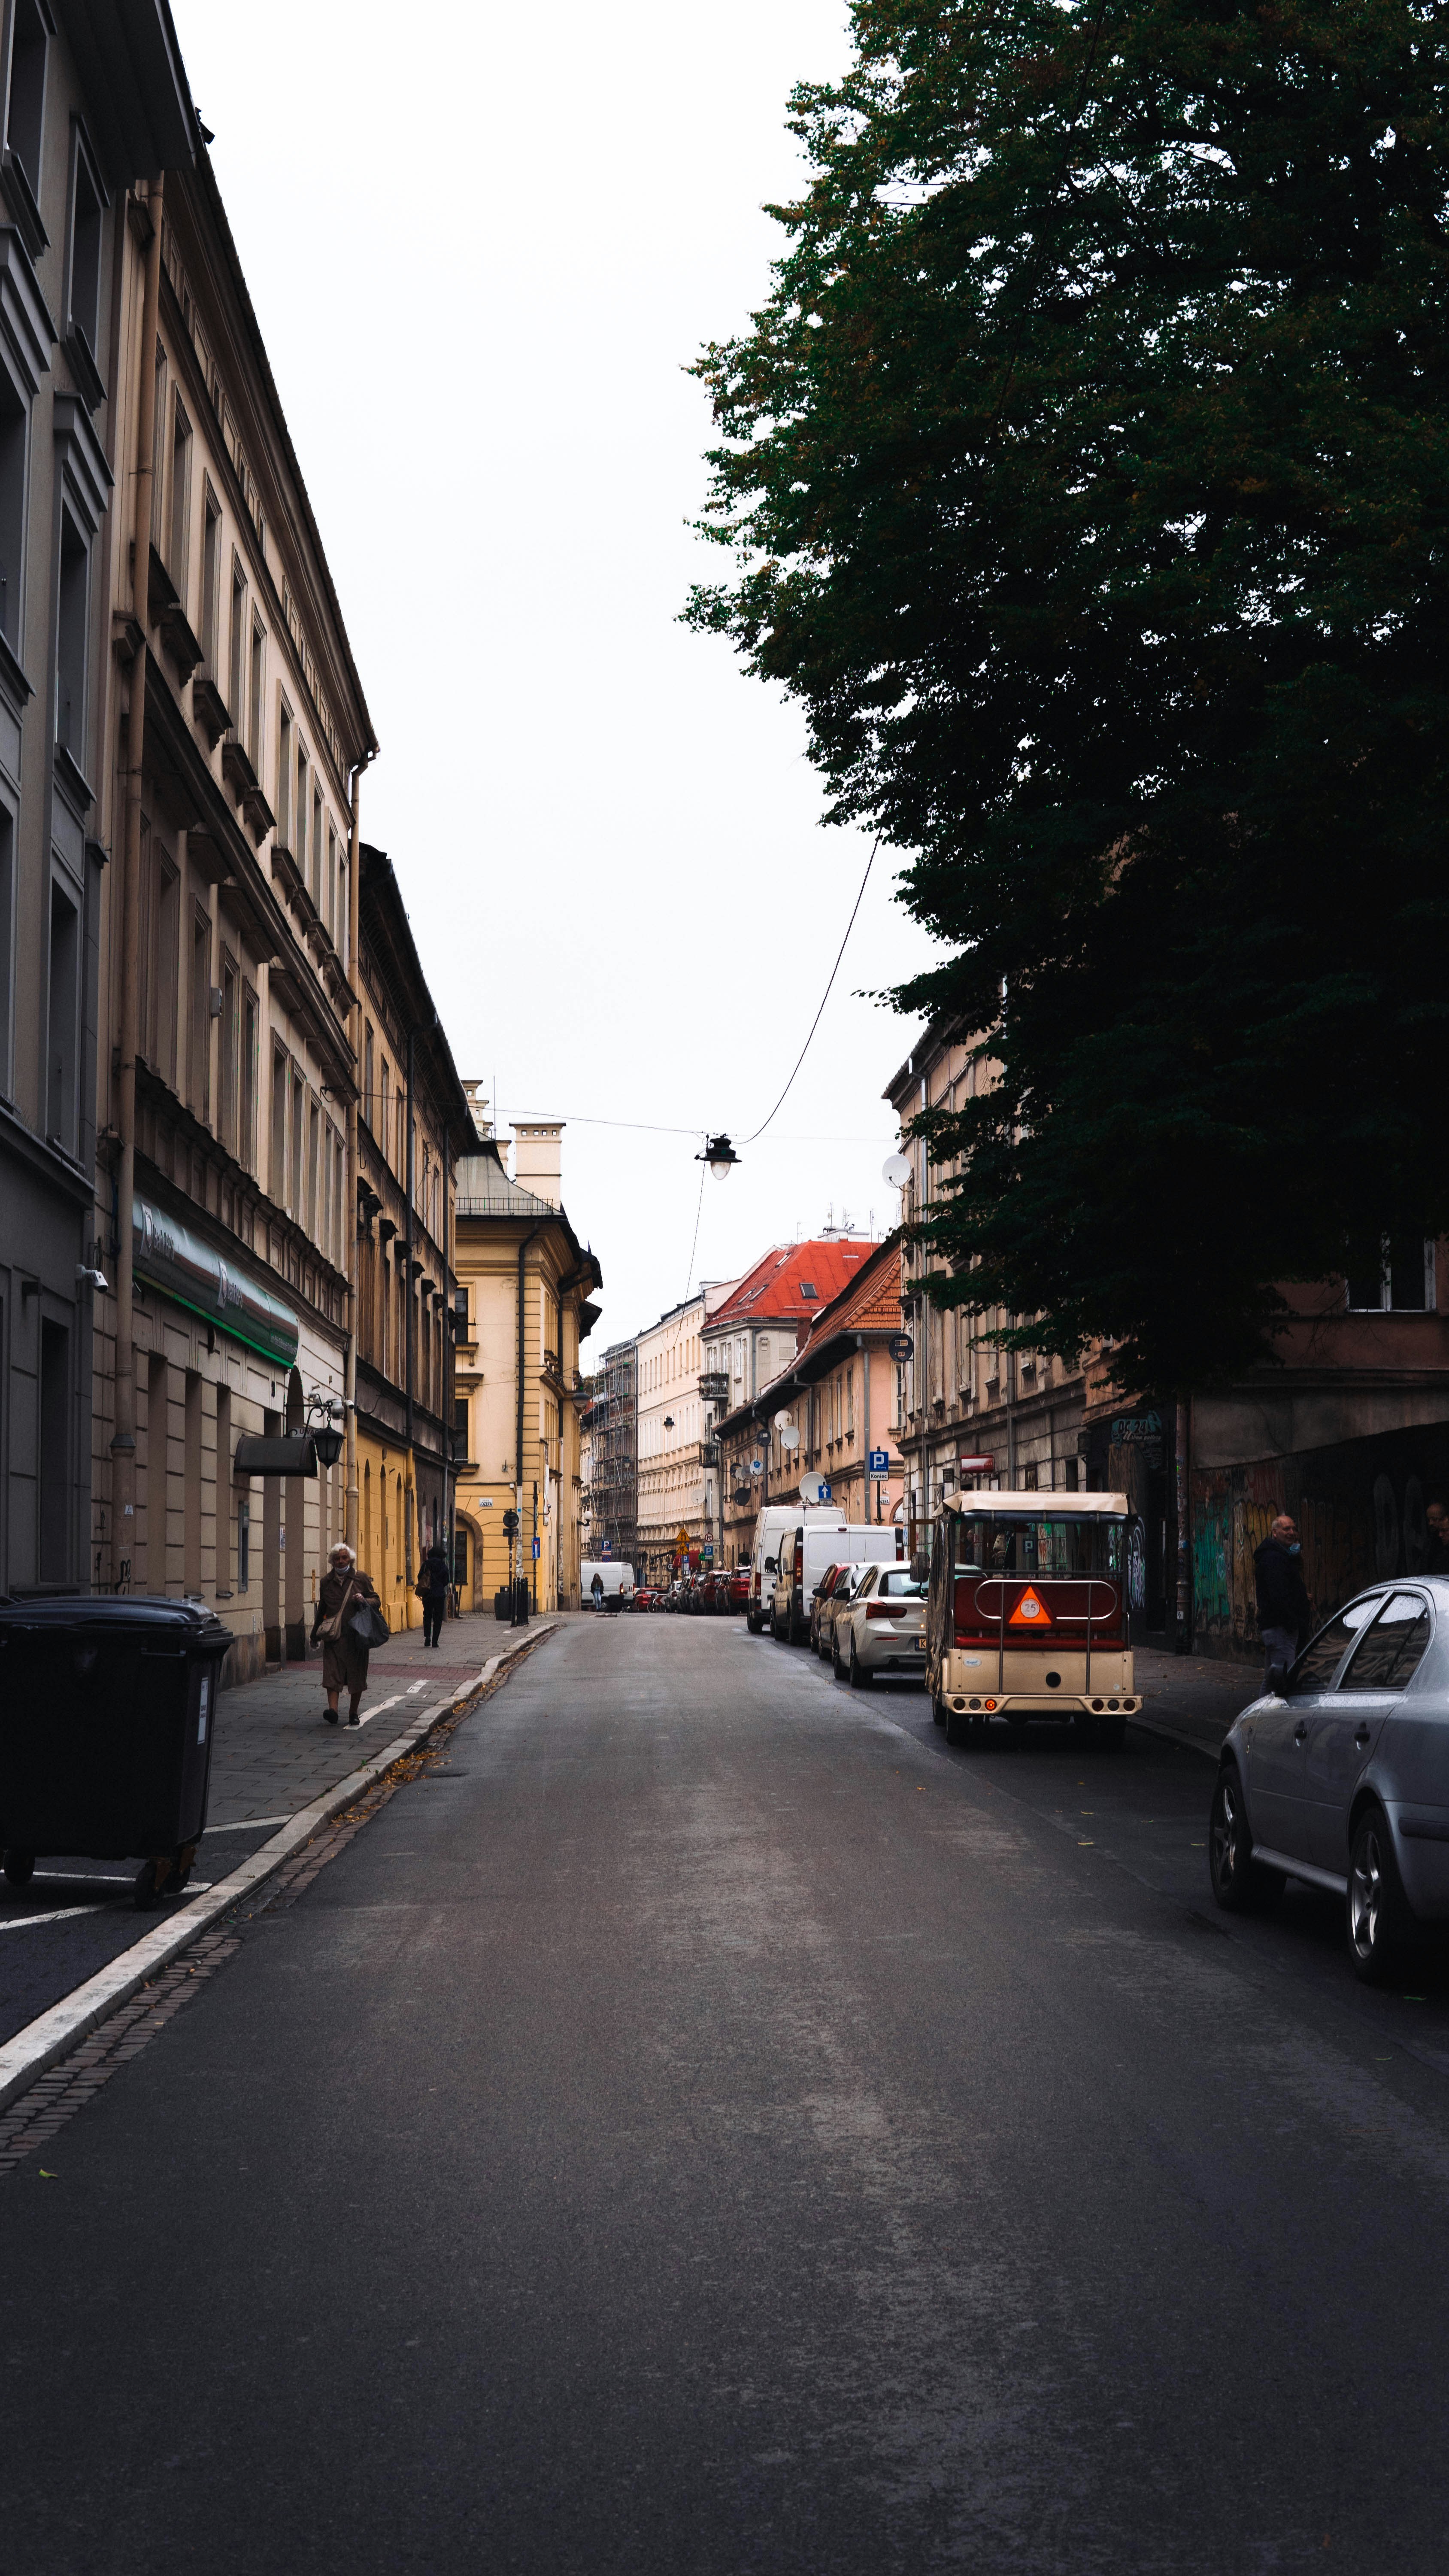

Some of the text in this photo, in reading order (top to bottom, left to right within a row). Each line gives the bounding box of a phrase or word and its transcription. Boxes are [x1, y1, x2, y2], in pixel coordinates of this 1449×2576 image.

[1134, 1420, 1146, 1434] 24
[873, 1454, 884, 1469] P
[1025, 1604, 1036, 1612] 25
